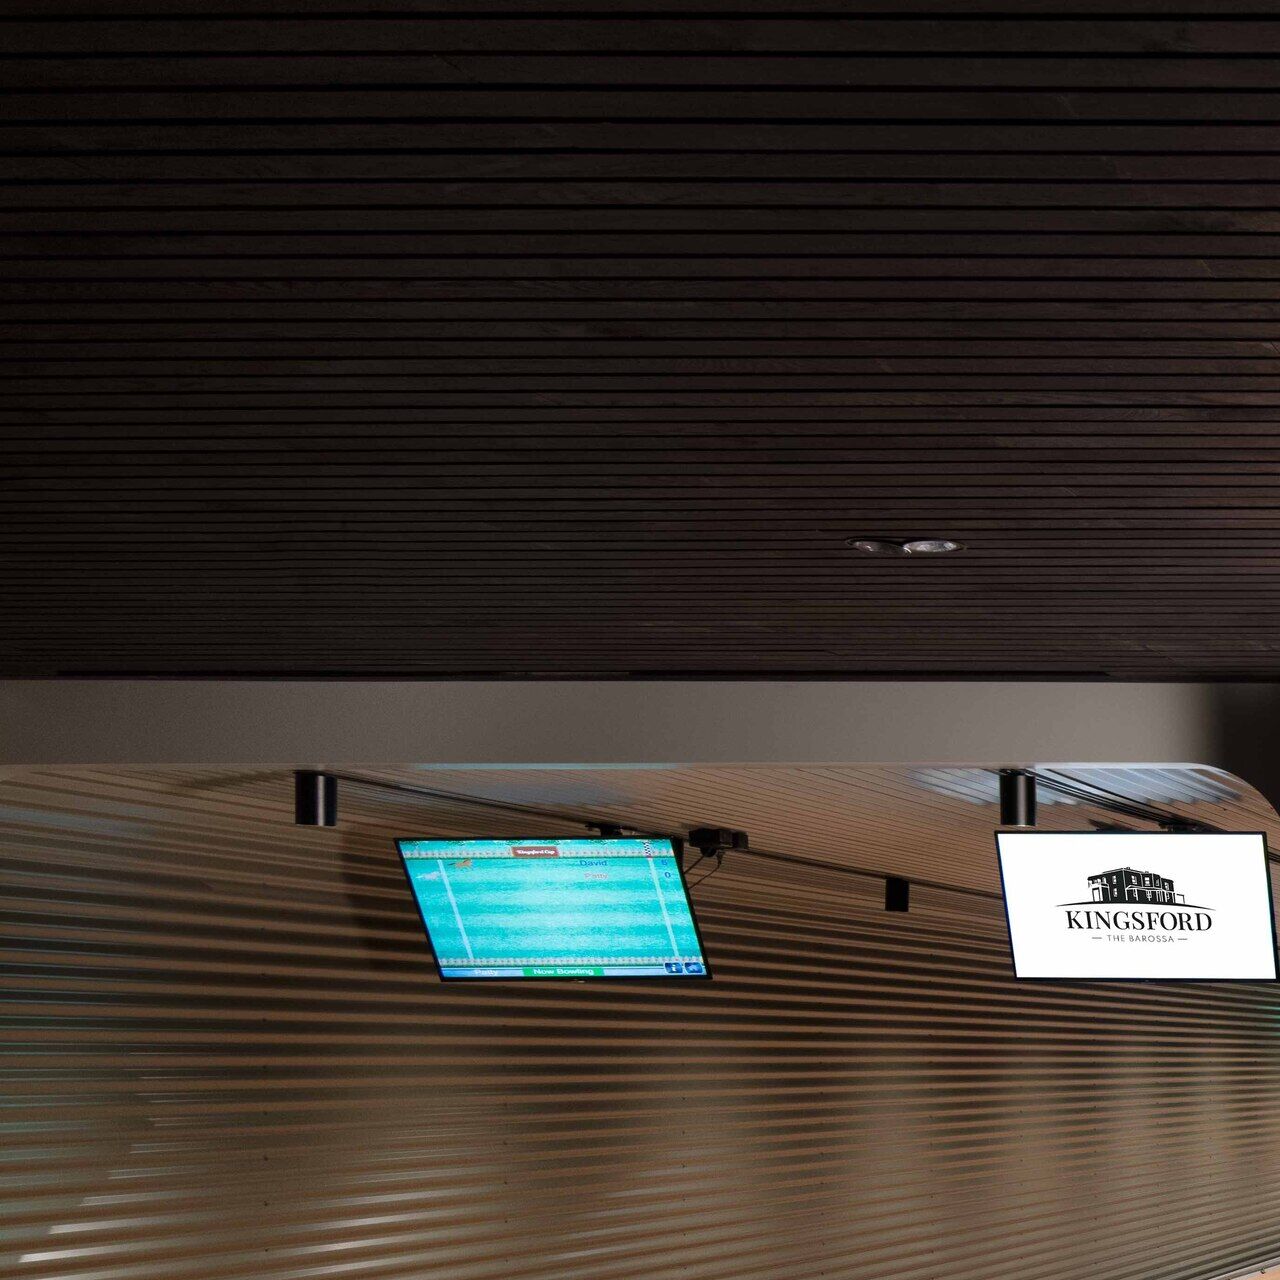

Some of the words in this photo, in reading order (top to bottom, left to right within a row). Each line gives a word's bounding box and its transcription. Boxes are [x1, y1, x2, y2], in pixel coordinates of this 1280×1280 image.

[1065, 910, 1213, 931] KINGSFORD
[1107, 934, 1126, 942] THE
[1129, 934, 1175, 943] BAROSSA
